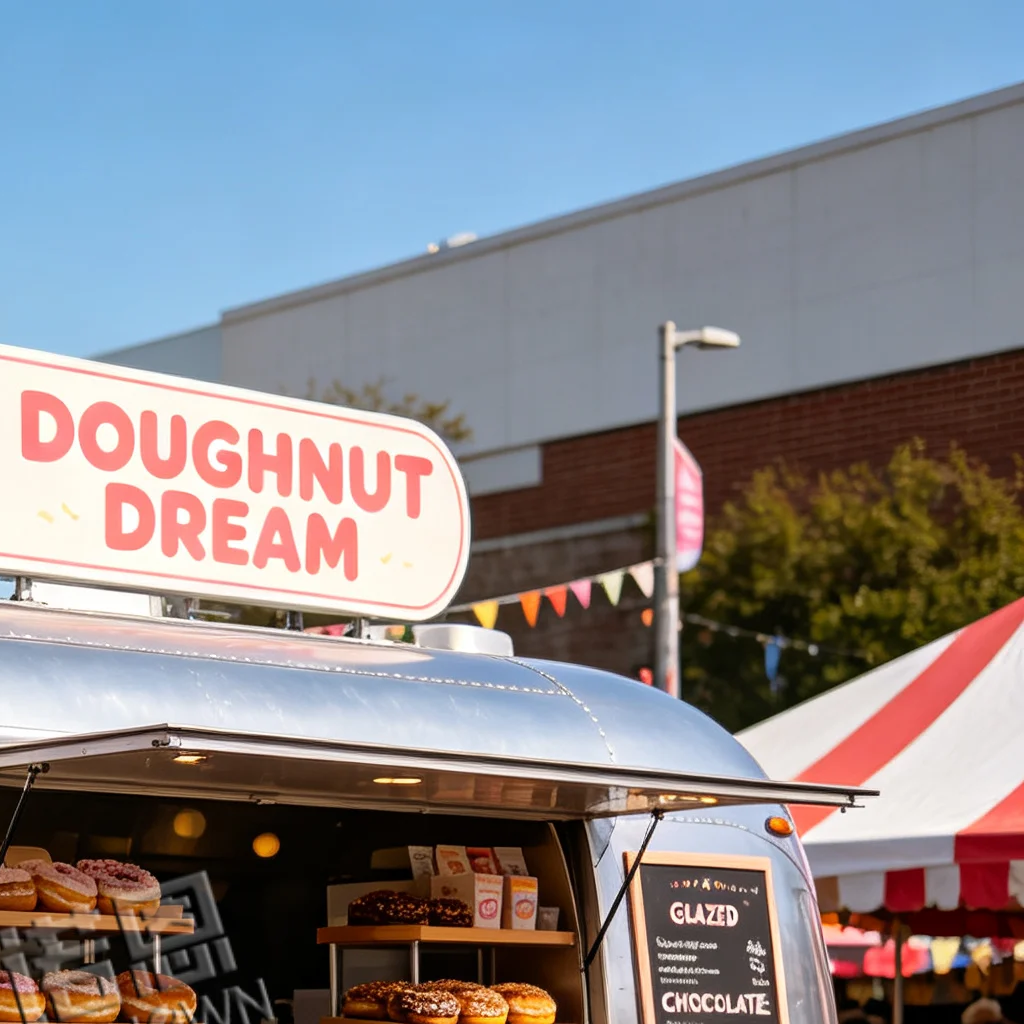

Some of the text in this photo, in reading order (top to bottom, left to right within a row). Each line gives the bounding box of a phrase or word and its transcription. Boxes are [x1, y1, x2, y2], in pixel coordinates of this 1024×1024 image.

[21, 389, 434, 519] DOUGHNUT
[104, 482, 359, 582] DREAM
[669, 901, 739, 927] GLAZED
[661, 992, 772, 1016] CHOCOLATE
